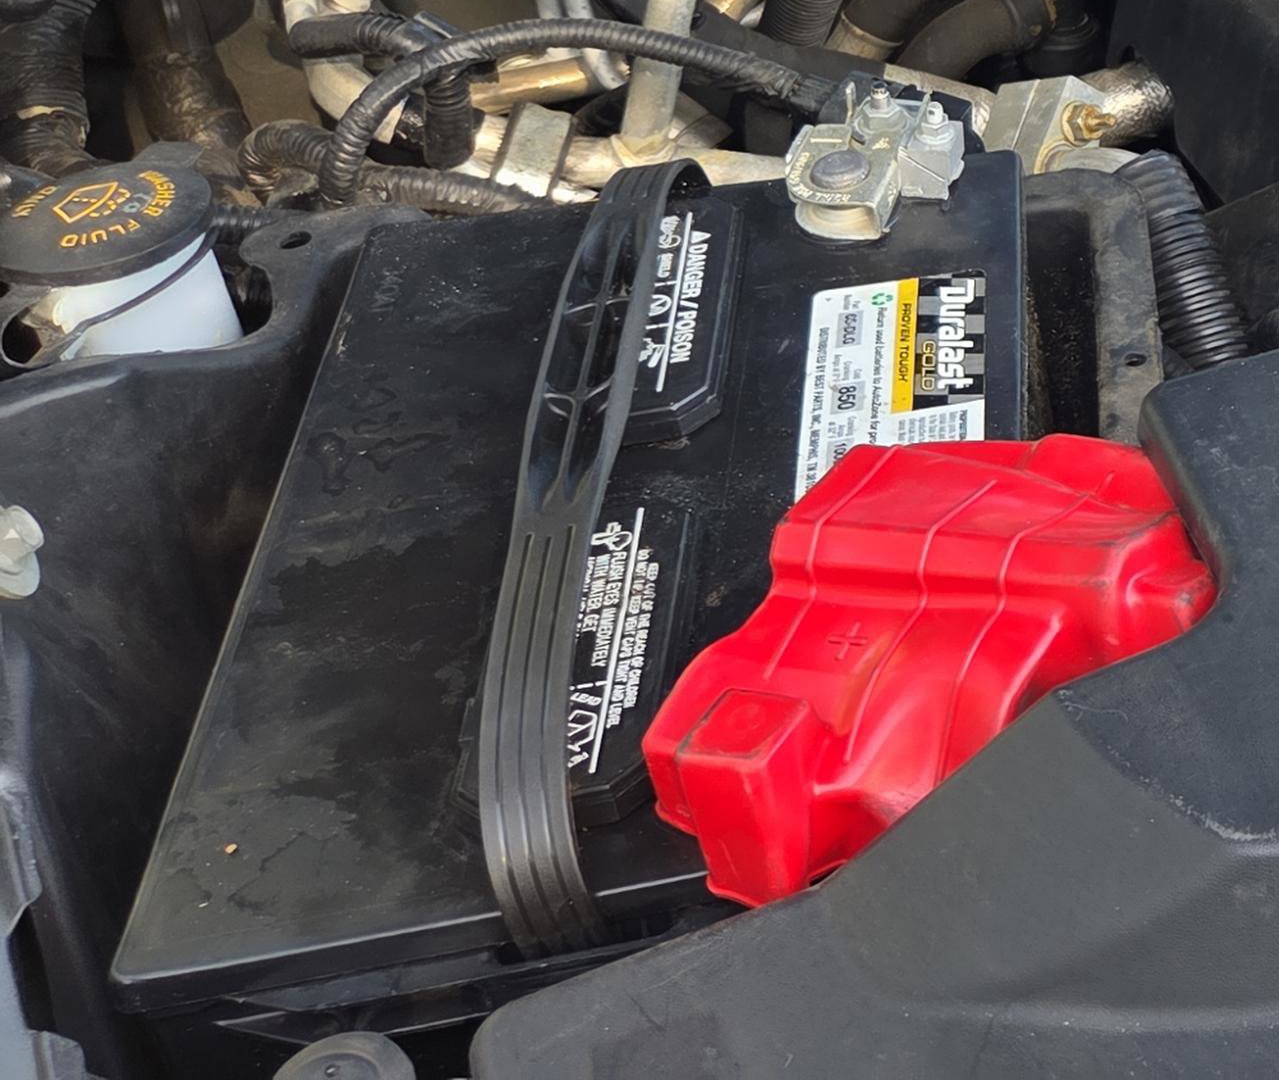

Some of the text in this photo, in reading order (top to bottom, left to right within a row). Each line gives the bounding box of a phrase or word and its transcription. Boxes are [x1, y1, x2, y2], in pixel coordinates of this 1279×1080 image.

[12, 170, 176, 248] WASHER FLUID ONLY
[684, 243, 709, 299] DANGER
[670, 309, 698, 364] POISON
[816, 327, 830, 364] DISTRIBUTED
[898, 302, 912, 382] PROVEN TOUGH
[937, 278, 976, 390] Duralast
[815, 365, 826, 373] BY
[867, 307, 888, 445] Return used batteries to AutoZone for pro
[920, 340, 937, 391] GOLD
[813, 374, 825, 390] BEST
[837, 385, 856, 410] 850
[807, 429, 821, 462] MEMPHIS,
[833, 442, 847, 461] 100
[593, 554, 611, 579] WITH
[590, 551, 627, 667] FLUSH EYES IMMEDIATELY
[642, 600, 654, 611] OF
[580, 614, 600, 633] GET
[624, 615, 638, 635] VENT
[619, 636, 634, 658] CAPS
[633, 628, 649, 656] REACH
[615, 660, 631, 683] TIGHT
[631, 656, 645, 668] OF
[612, 684, 626, 702] AND
[623, 668, 642, 708] CHILDREN
